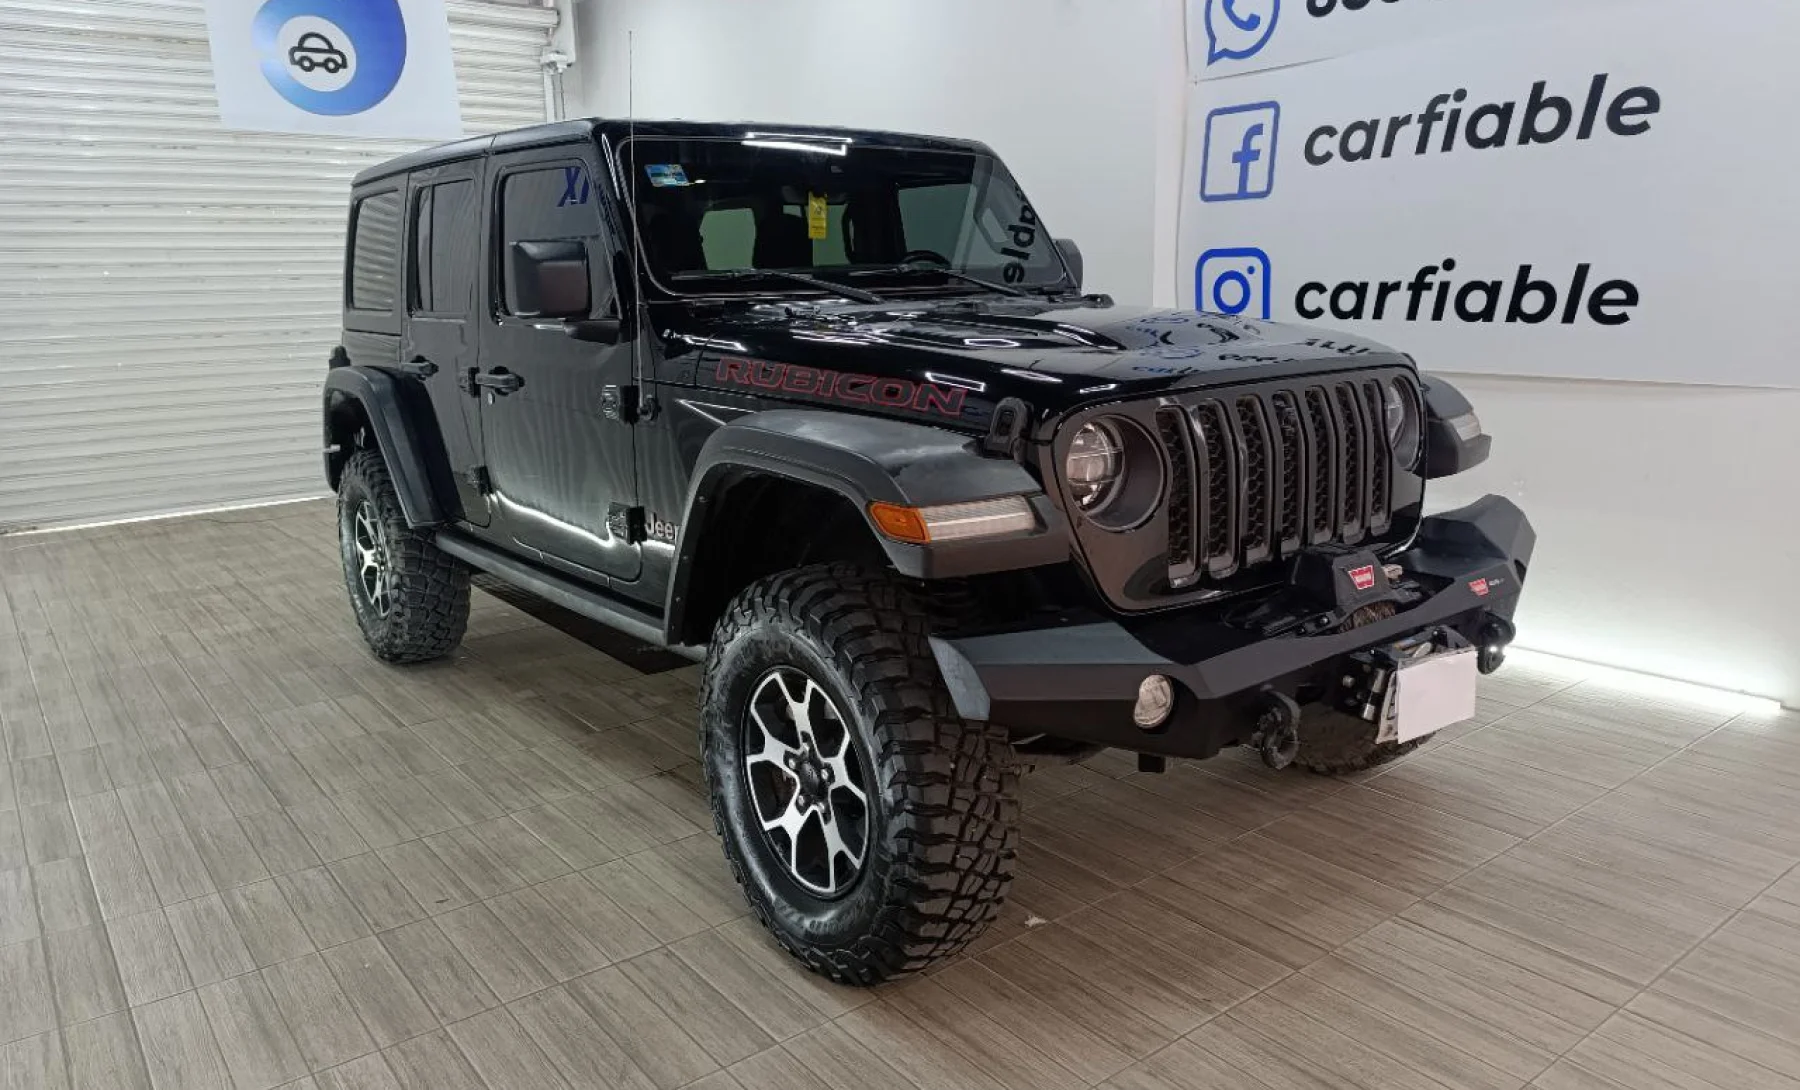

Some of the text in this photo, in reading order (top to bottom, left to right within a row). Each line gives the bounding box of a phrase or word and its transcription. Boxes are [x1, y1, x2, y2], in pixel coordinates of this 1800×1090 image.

[1303, 72, 1661, 166] carfiable
[1294, 257, 1640, 326] carfiable
[715, 356, 968, 416] RUBICON
